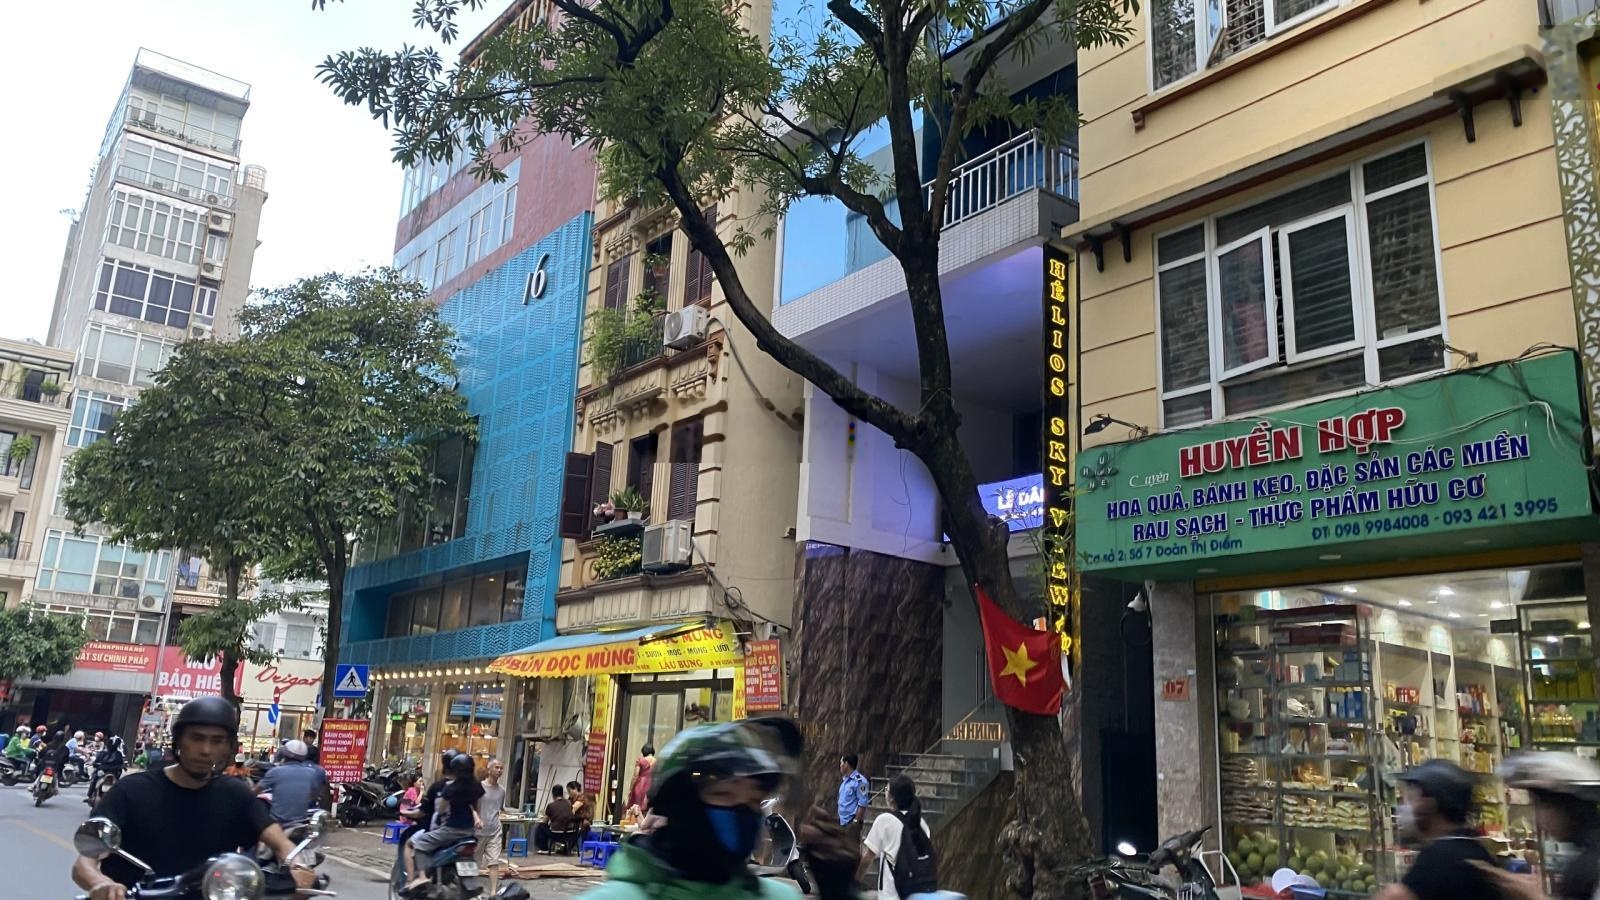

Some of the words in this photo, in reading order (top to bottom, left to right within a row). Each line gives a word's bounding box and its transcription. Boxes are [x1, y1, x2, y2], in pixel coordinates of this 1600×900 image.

[521, 253, 549, 305] 16
[1049, 417, 1066, 486] SKY
[1179, 421, 1303, 479] HUYỀN
[1318, 407, 1407, 455] HỢP
[1107, 498, 1142, 520] HOA
[1147, 485, 1189, 516] QUẢ,
[1192, 480, 1247, 508] BÁNH
[1253, 473, 1301, 501] KẸO,
[1306, 464, 1347, 492] ĐẶC
[1354, 452, 1400, 483] SẢN
[1406, 443, 1455, 474] CÁC
[1461, 430, 1529, 467] MIỀN
[1133, 519, 1170, 542] RAU
[1175, 512, 1228, 540] SẠCH
[1248, 500, 1303, 529] THỰC
[1310, 486, 1380, 519] PHẨM
[1386, 479, 1439, 509] HỮU
[1448, 473, 1487, 500] CƠ
[1335, 522, 1360, 538] 098
[1366, 513, 1430, 534] 9984008
[1443, 508, 1473, 525] 093
[1478, 505, 1507, 521] 421
[1514, 498, 1559, 517] 3995
[1147, 547, 1152, 558] 7
[158, 668, 191, 688] BẢO
[506, 655, 545, 673] BÚN
[585, 647, 635, 670] MÙNG
